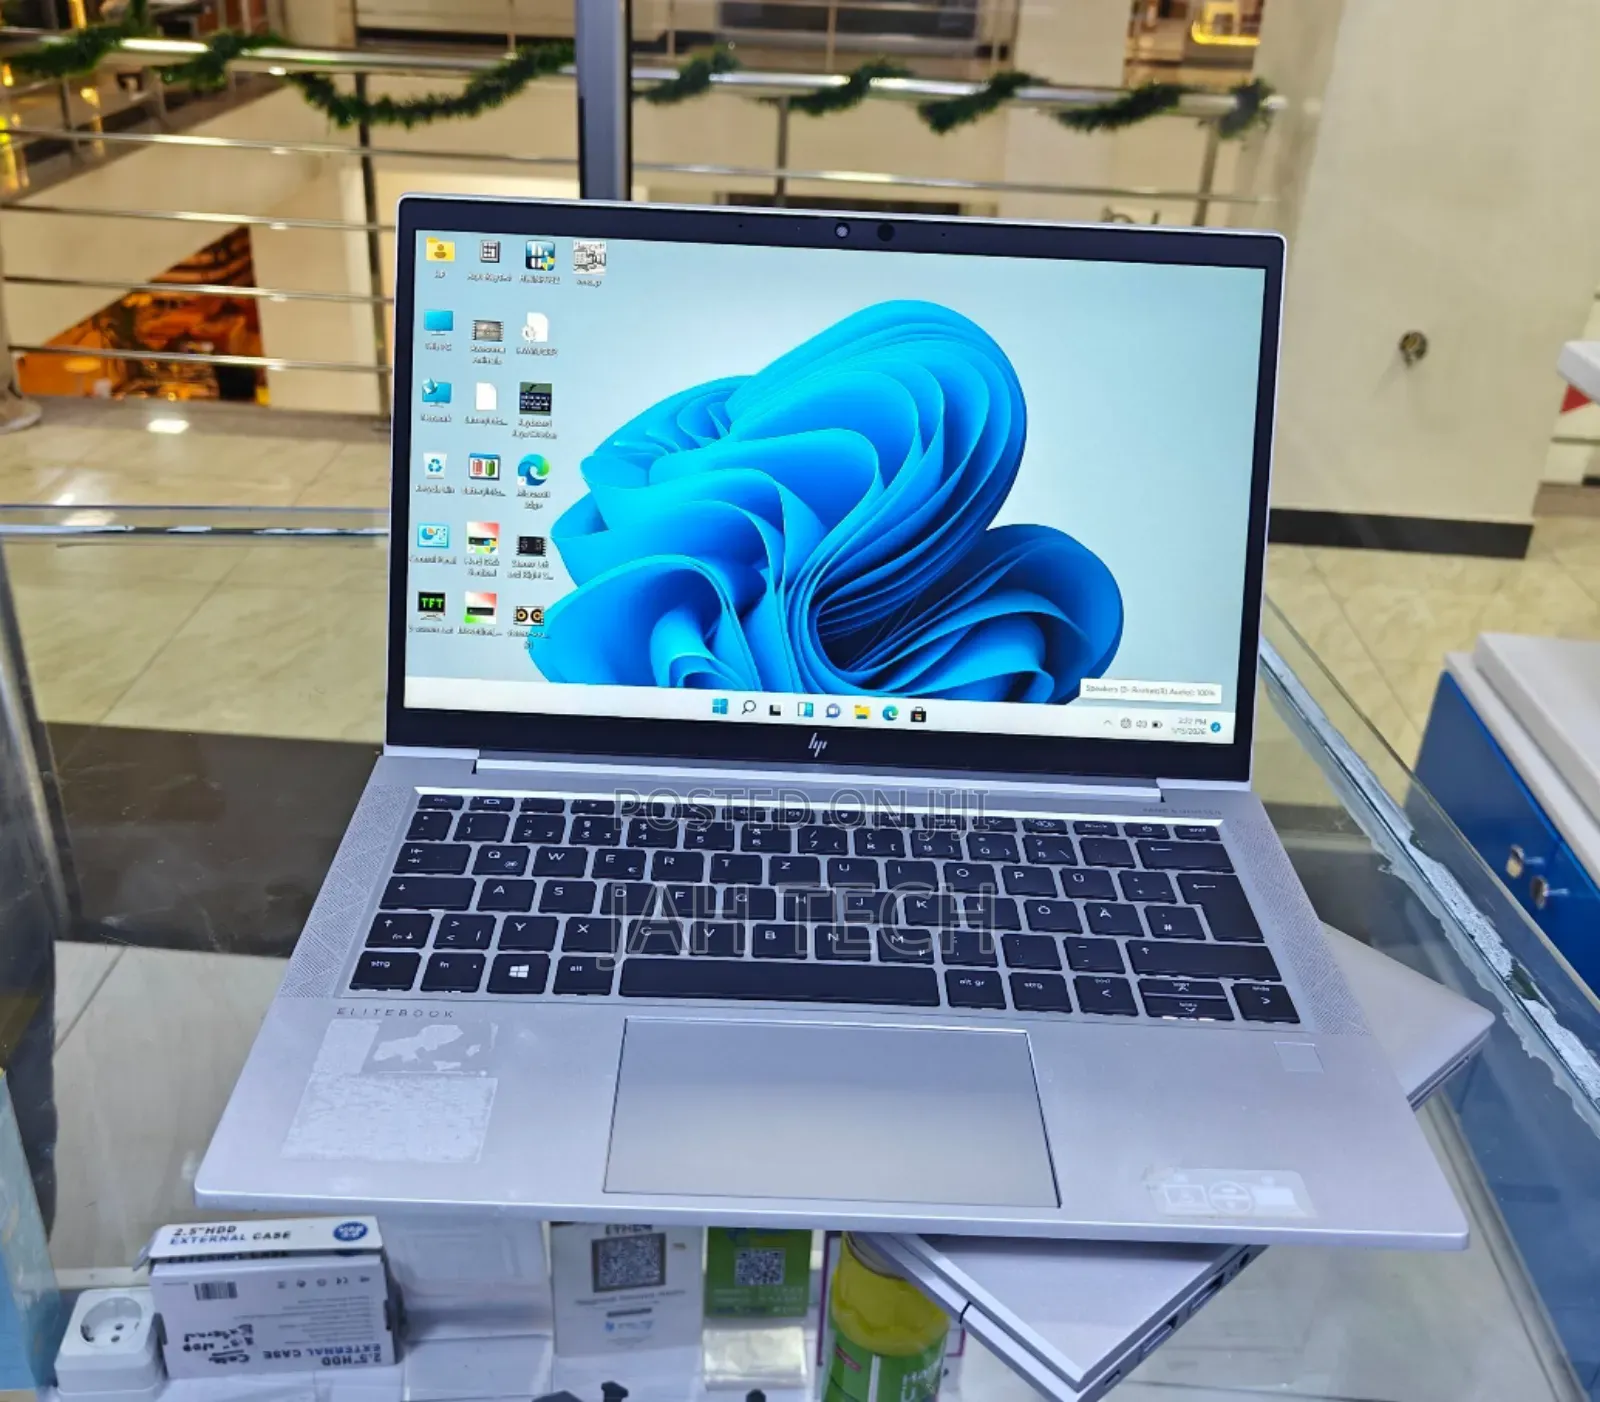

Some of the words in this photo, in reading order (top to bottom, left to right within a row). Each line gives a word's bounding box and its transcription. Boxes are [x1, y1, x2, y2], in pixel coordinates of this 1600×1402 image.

[421, 597, 443, 608] TFT
[808, 732, 827, 758] hp
[488, 851, 501, 859] Q
[548, 852, 565, 861] W
[605, 854, 616, 863] E
[664, 857, 675, 865] R
[721, 859, 730, 867] T
[780, 862, 791, 870] Z
[838, 863, 850, 872] U
[956, 868, 970, 878] O
[1013, 871, 1024, 879] P
[493, 885, 505, 894] A
[554, 886, 564, 896] S
[615, 888, 627, 897] D
[674, 891, 685, 900] F
[735, 894, 748, 903] G
[795, 895, 807, 904] H
[855, 898, 864, 907] J
[916, 900, 927, 909] K
[514, 922, 527, 931] Y
[577, 924, 589, 933] X
[640, 926, 652, 936] C
[703, 928, 715, 938] V
[764, 930, 776, 940] B
[827, 932, 839, 941] N
[891, 935, 905, 944] M
[371, 960, 391, 968] strg
[1024, 982, 1043, 990] strg
[336, 1006, 455, 1018] ELITEBOOK
[170, 1233, 246, 1246] EXTERNAL
[252, 1231, 292, 1241] CASE
[263, 1349, 301, 1360] CASE
[310, 1343, 381, 1357] EXTERNAL
